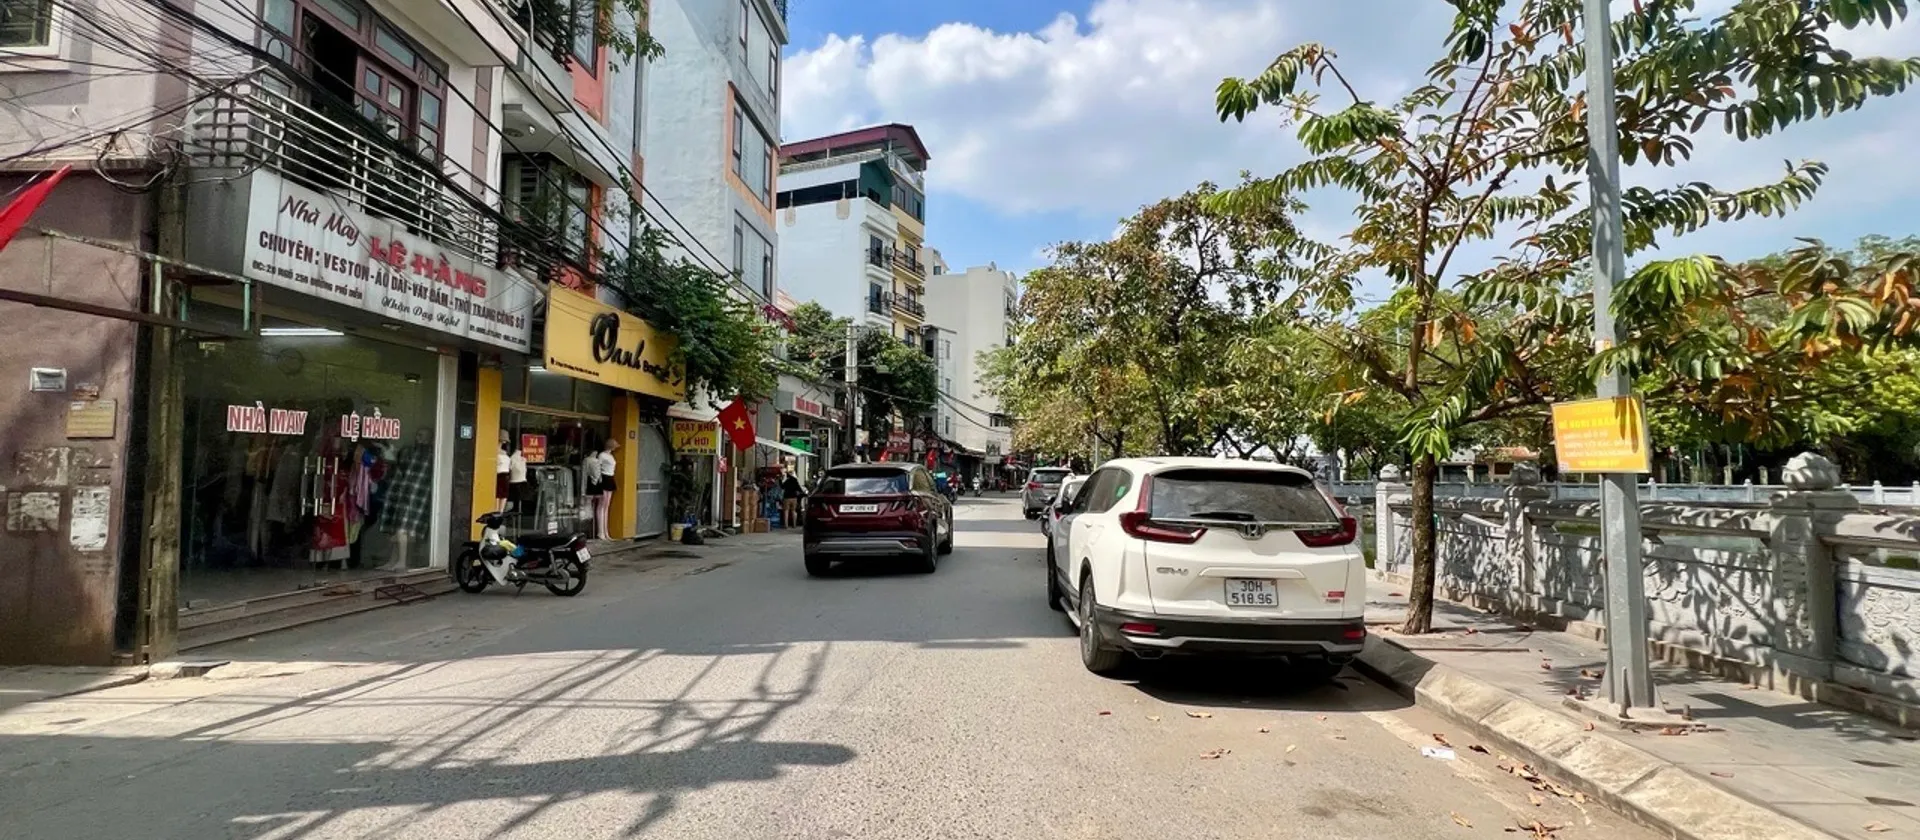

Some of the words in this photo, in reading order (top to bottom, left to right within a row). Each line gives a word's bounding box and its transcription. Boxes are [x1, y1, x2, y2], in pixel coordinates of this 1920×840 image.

[280, 195, 320, 226] Nhà
[323, 212, 360, 247] May
[590, 312, 645, 370] Oanh
[227, 400, 267, 433] NHÀ
[269, 408, 308, 435] MAY
[341, 410, 360, 442] LỆ
[1156, 567, 1189, 576] CR-V
[1231, 592, 1272, 604] 518.96
[1240, 580, 1262, 592] 30H
